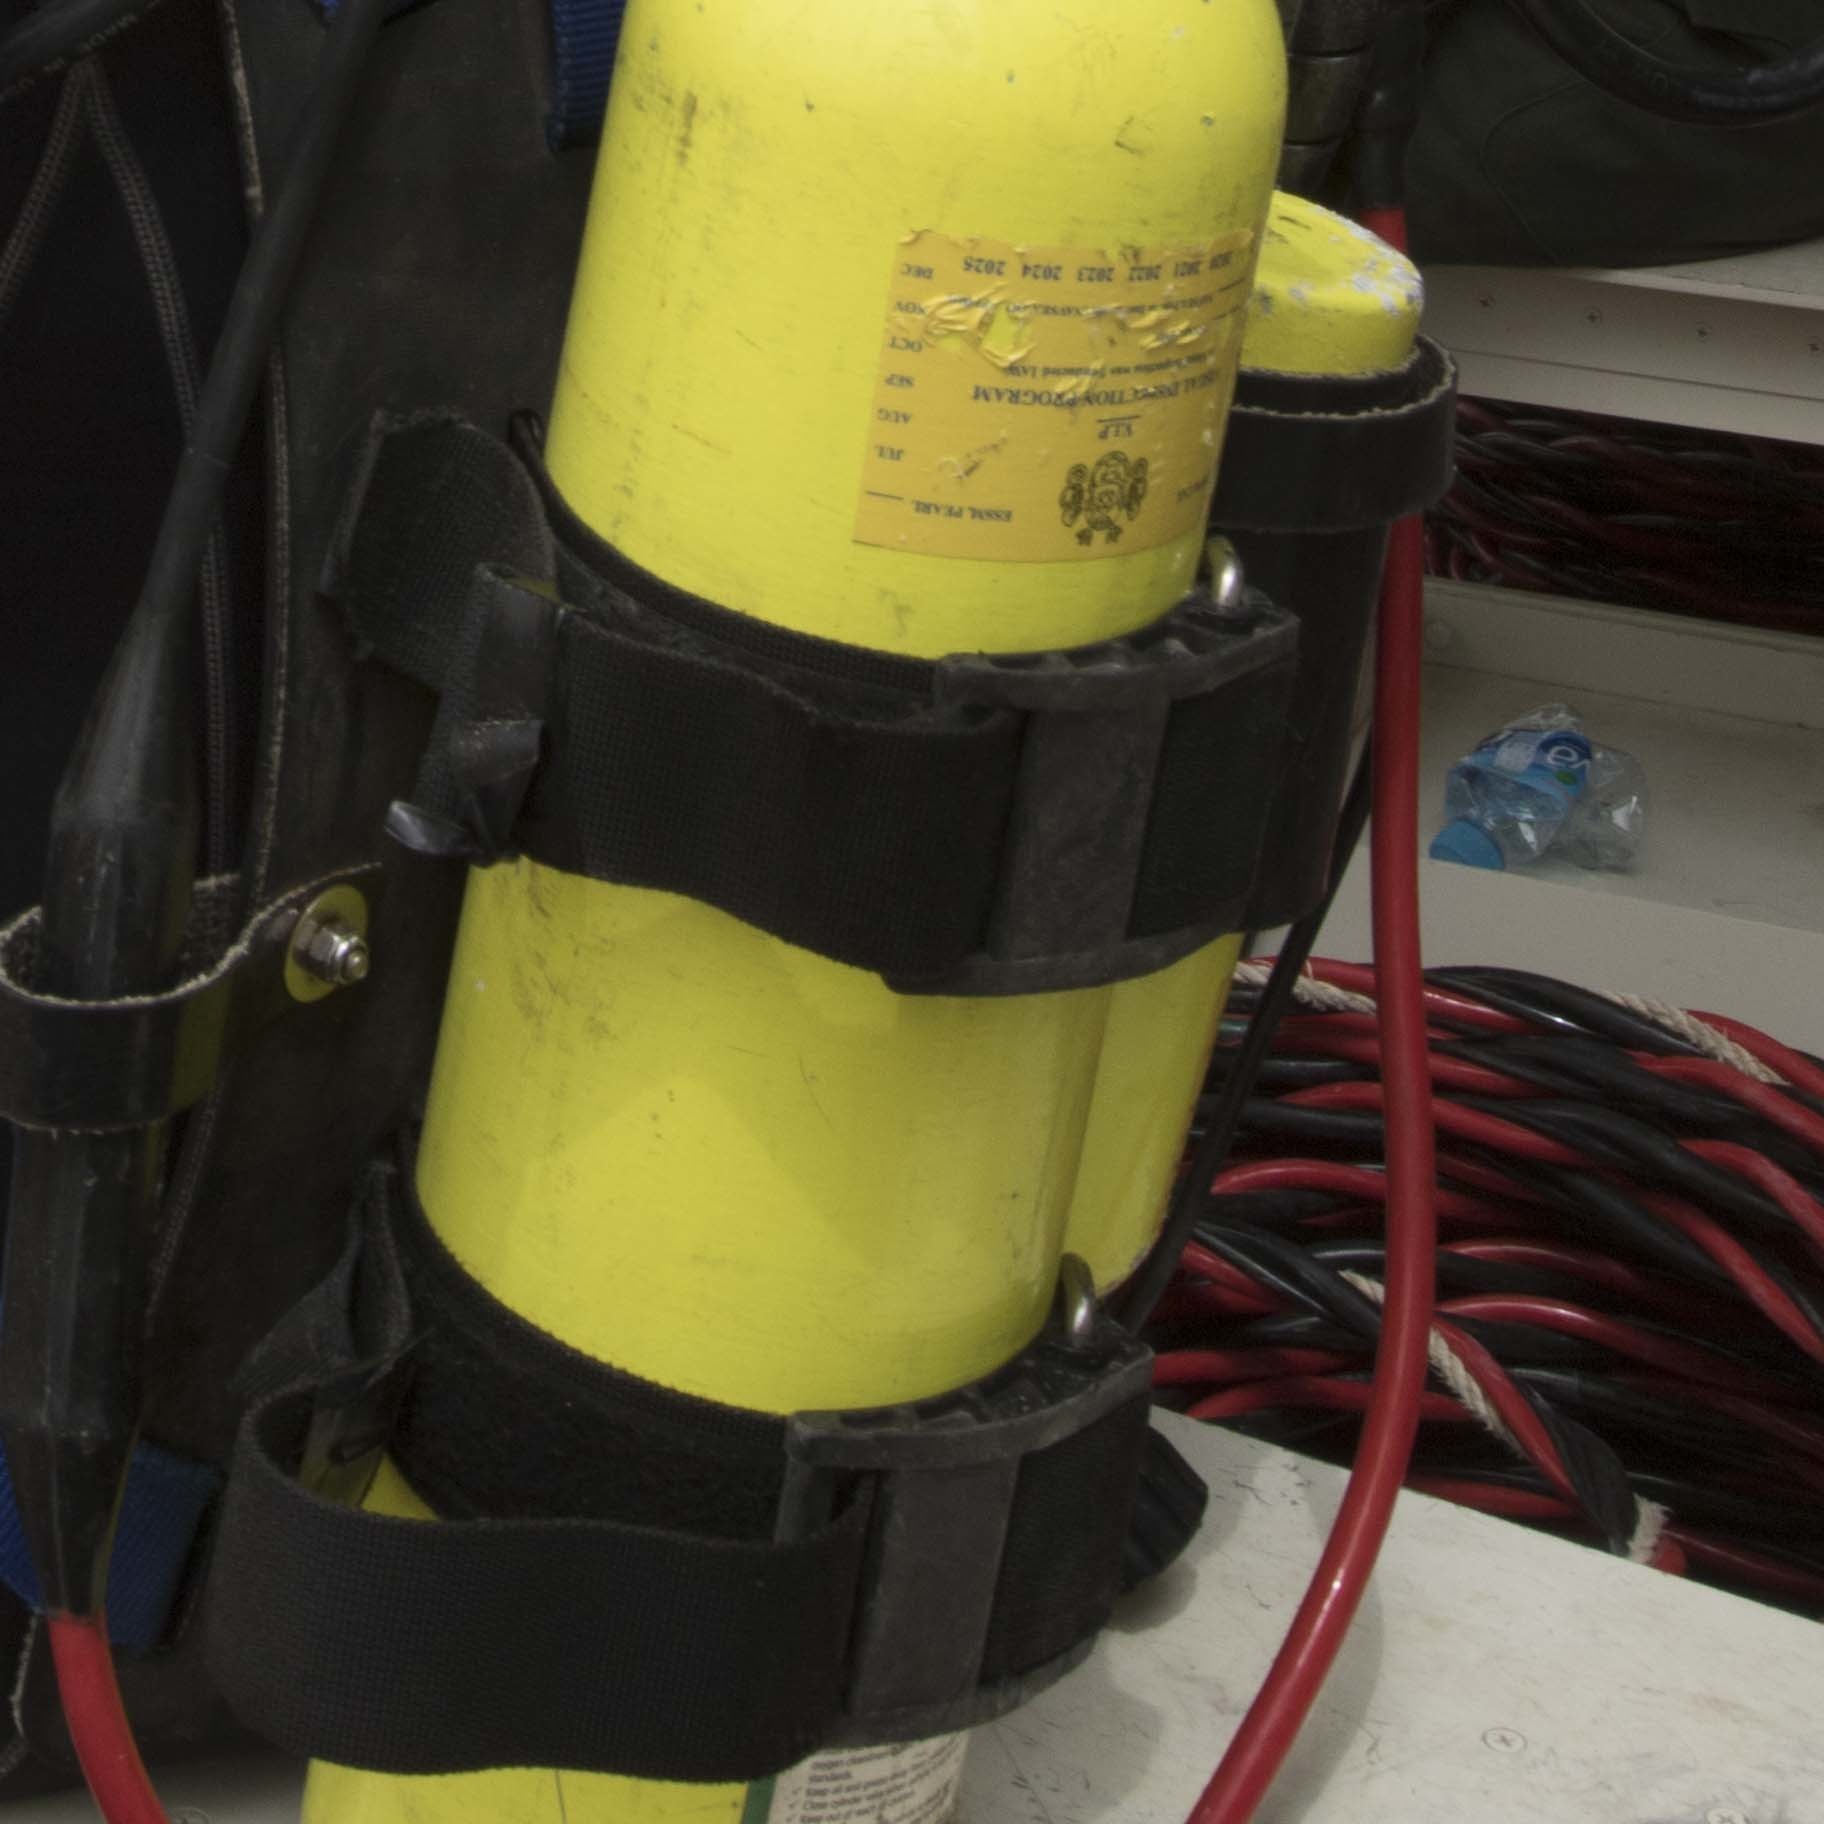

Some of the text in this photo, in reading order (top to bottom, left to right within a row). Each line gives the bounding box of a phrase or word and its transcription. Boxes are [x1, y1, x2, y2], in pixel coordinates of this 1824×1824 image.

[900, 263, 934, 280] DEC
[963, 256, 1007, 277] 2025
[1021, 262, 1063, 281] 2024
[1077, 265, 1115, 283] 2023
[1128, 264, 1162, 283] 2022
[895, 300, 928, 315] NOV
[887, 336, 923, 352] OCT
[884, 374, 915, 389] SEP
[972, 384, 1078, 408] PROGRAM
[876, 408, 912, 425] AUG
[874, 445, 905, 461] JUL
[911, 499, 966, 518] PEARL
